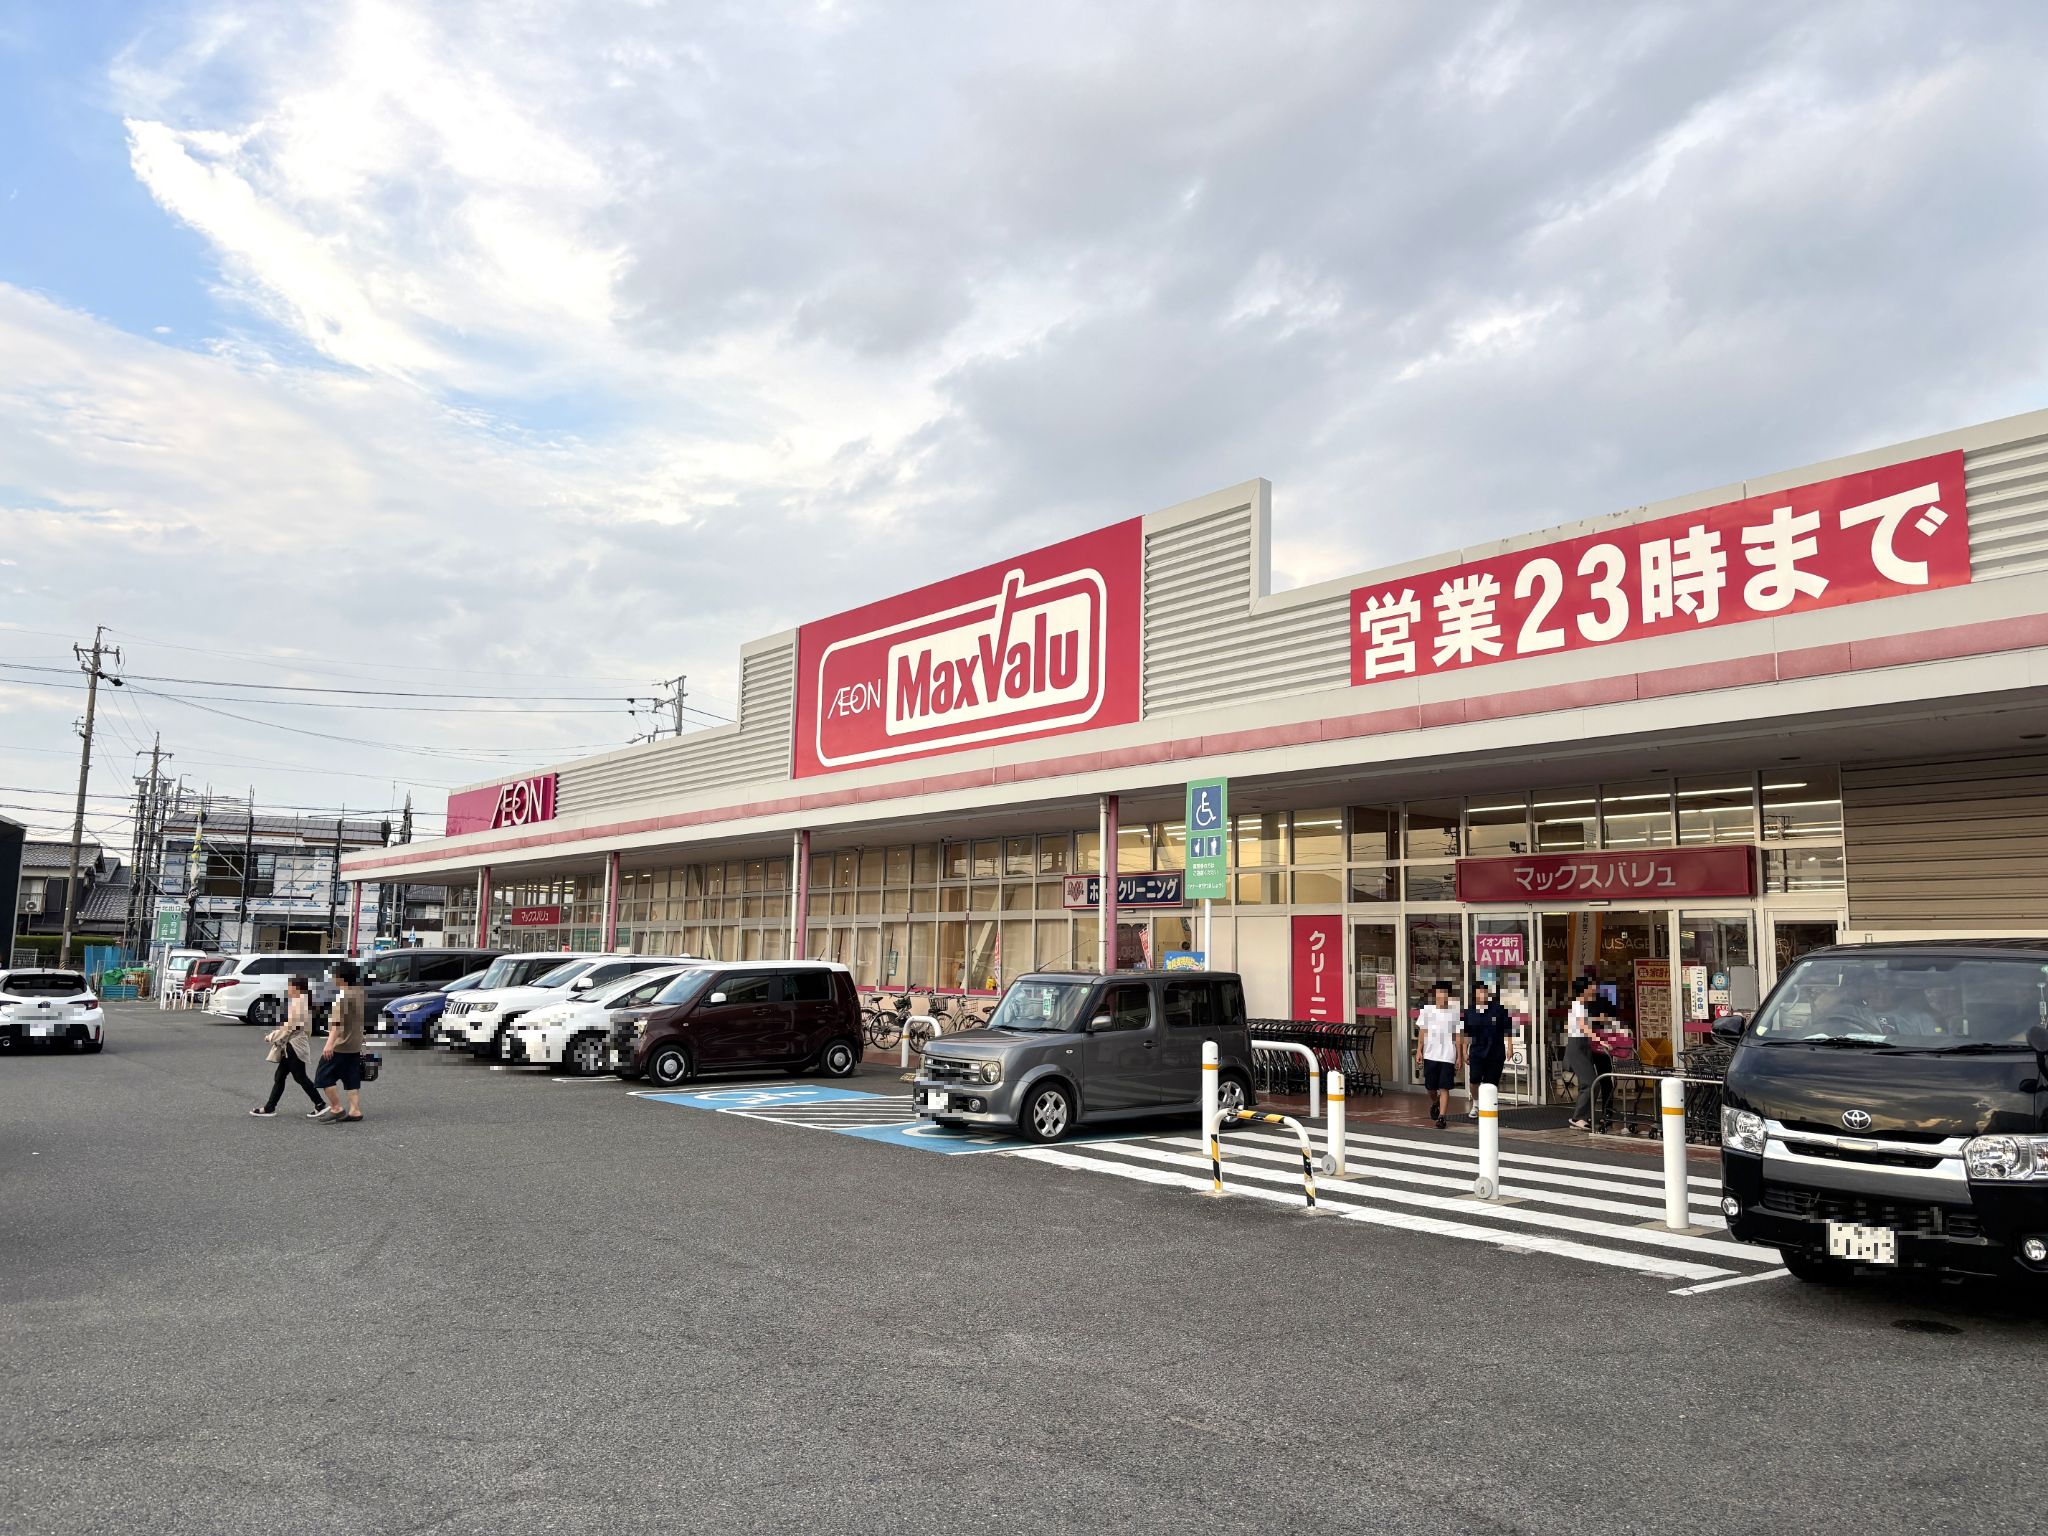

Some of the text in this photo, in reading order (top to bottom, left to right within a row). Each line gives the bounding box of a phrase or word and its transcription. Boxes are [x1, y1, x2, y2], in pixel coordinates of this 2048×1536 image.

[1360, 482, 1949, 679] 営業23時まで
[896, 578, 1079, 722] MaxValu
[1513, 861, 1676, 891] マックスバリュ
[521, 911, 549, 922] マックスバリュ
[1480, 937, 1519, 947] イオン銀行
[1481, 949, 1520, 965] ATM
